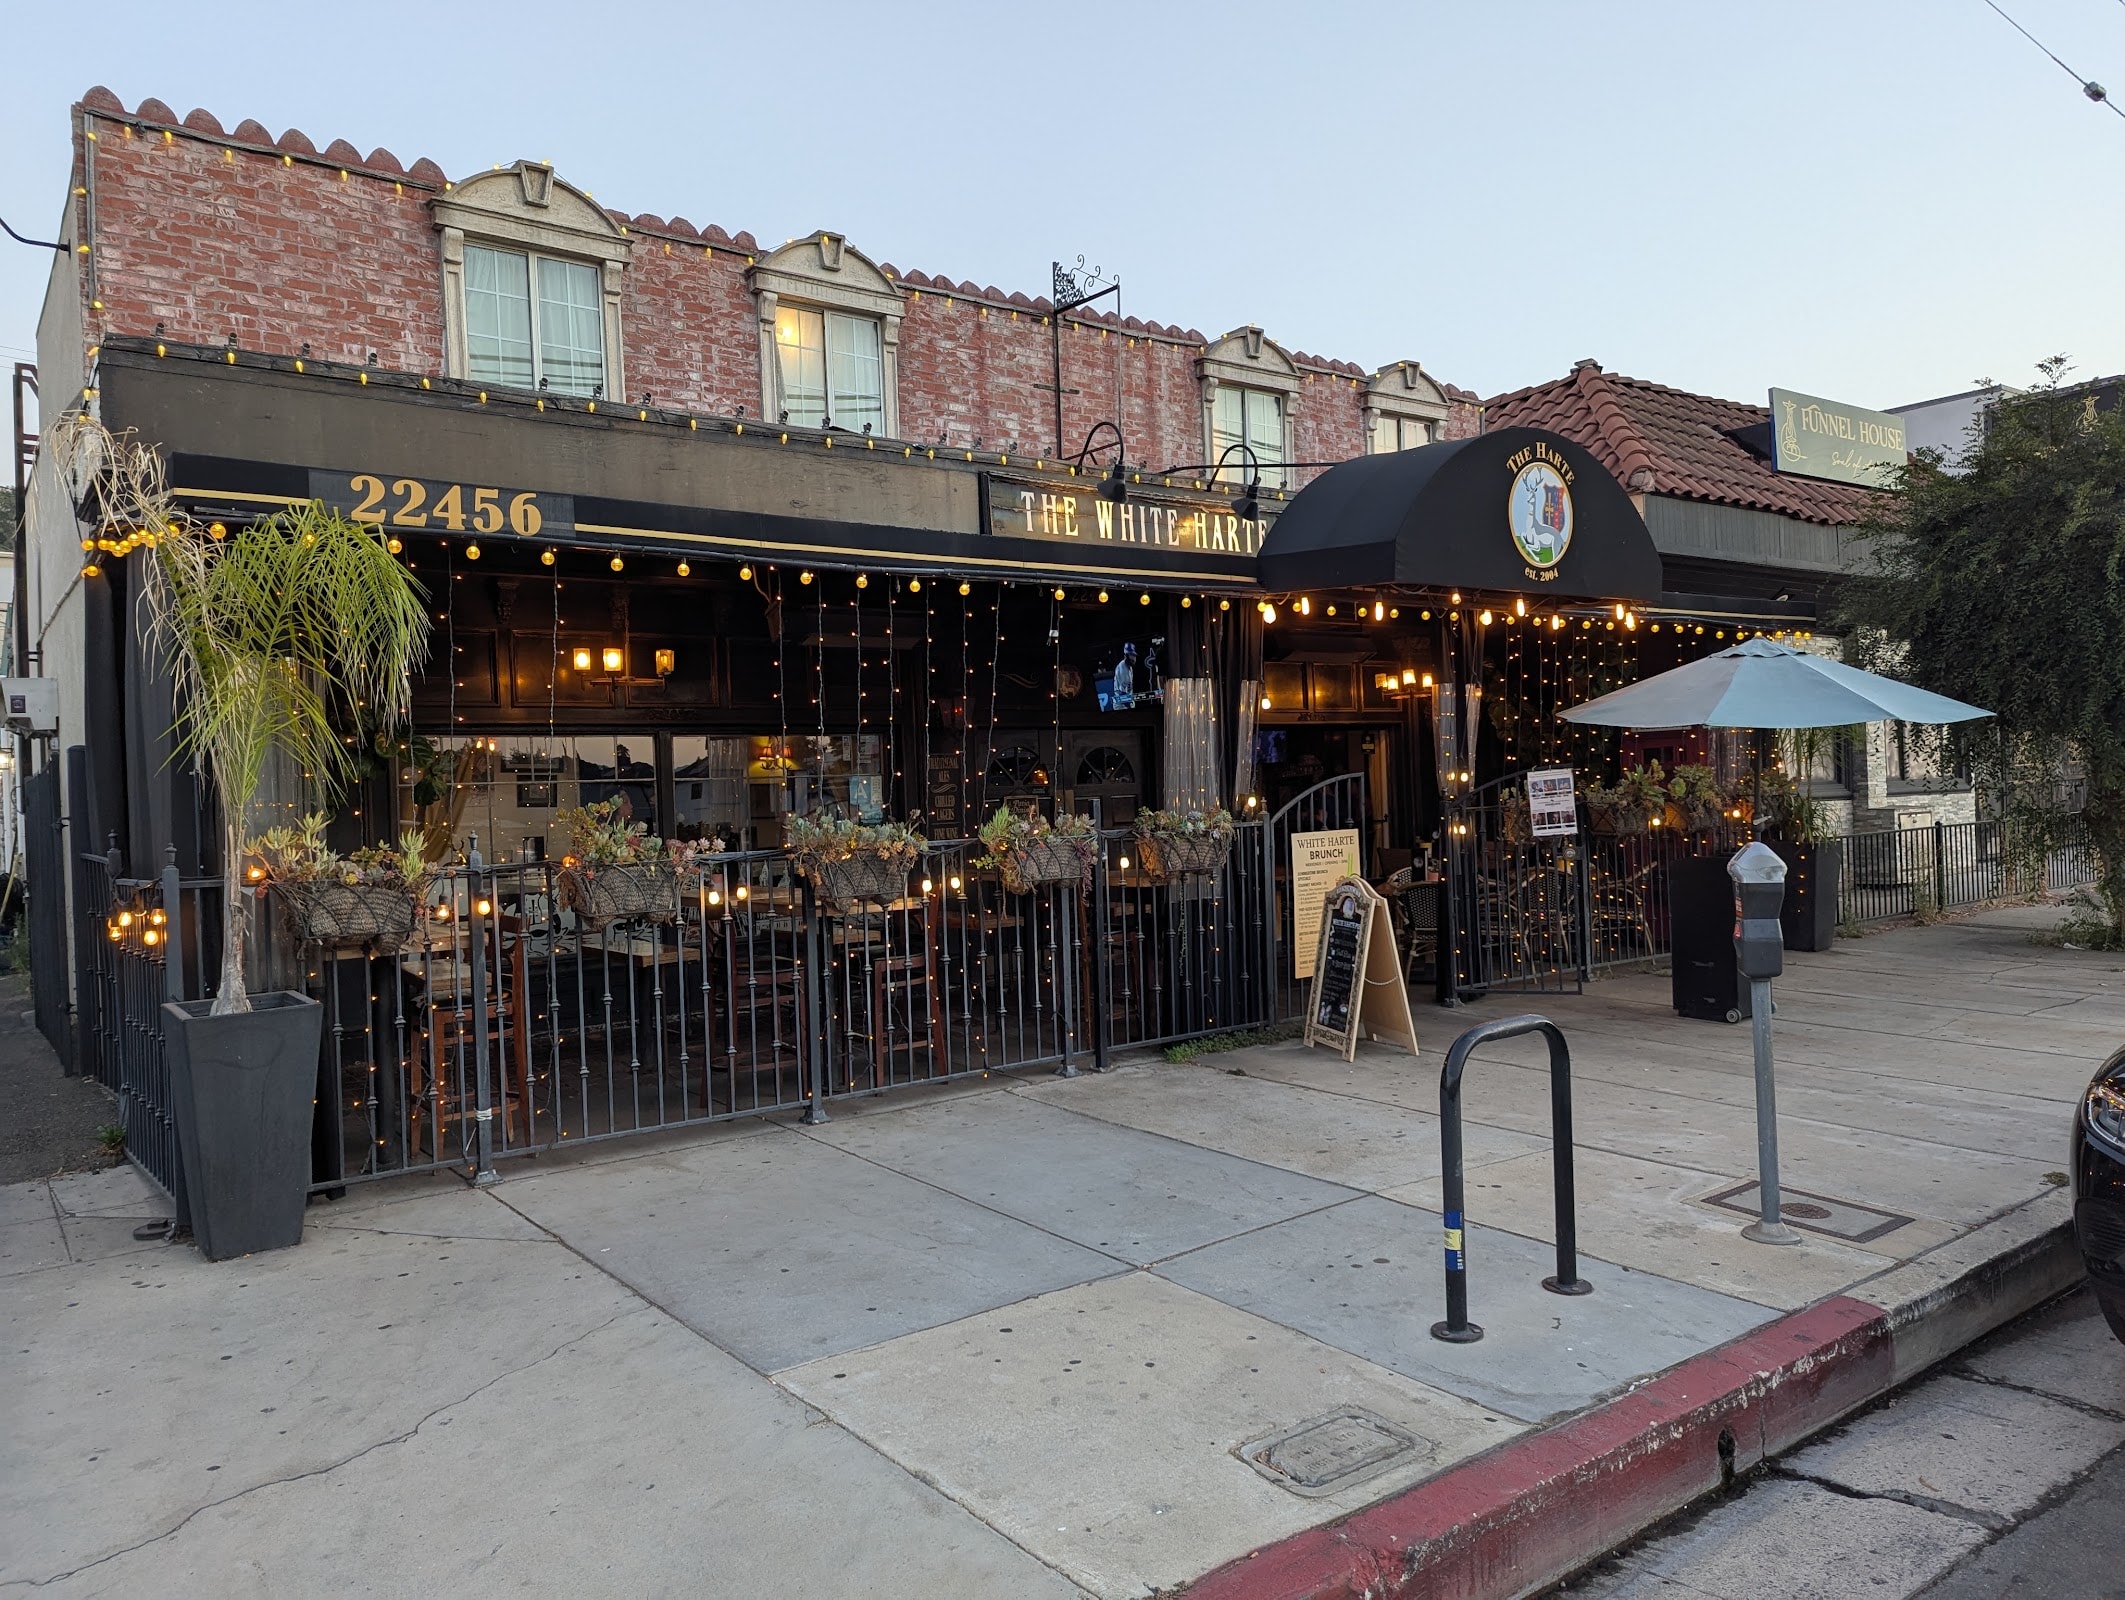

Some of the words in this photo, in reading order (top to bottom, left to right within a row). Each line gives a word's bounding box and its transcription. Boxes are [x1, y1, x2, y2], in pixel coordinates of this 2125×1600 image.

[1801, 404, 1856, 441] FUNNEL
[1859, 421, 1904, 451] HOUSE
[1506, 446, 1533, 475] THE
[1535, 441, 1576, 486] HARTE
[350, 474, 542, 537] 22456
[1020, 491, 1079, 537] THE
[1095, 500, 1180, 547] WHITE
[1193, 512, 1268, 554] HARTE
[1540, 567, 1559, 582] 2004
[1297, 837, 1326, 849] WHITE
[1327, 835, 1355, 847] HARTE
[1309, 848, 1344, 860] BRUNCH
